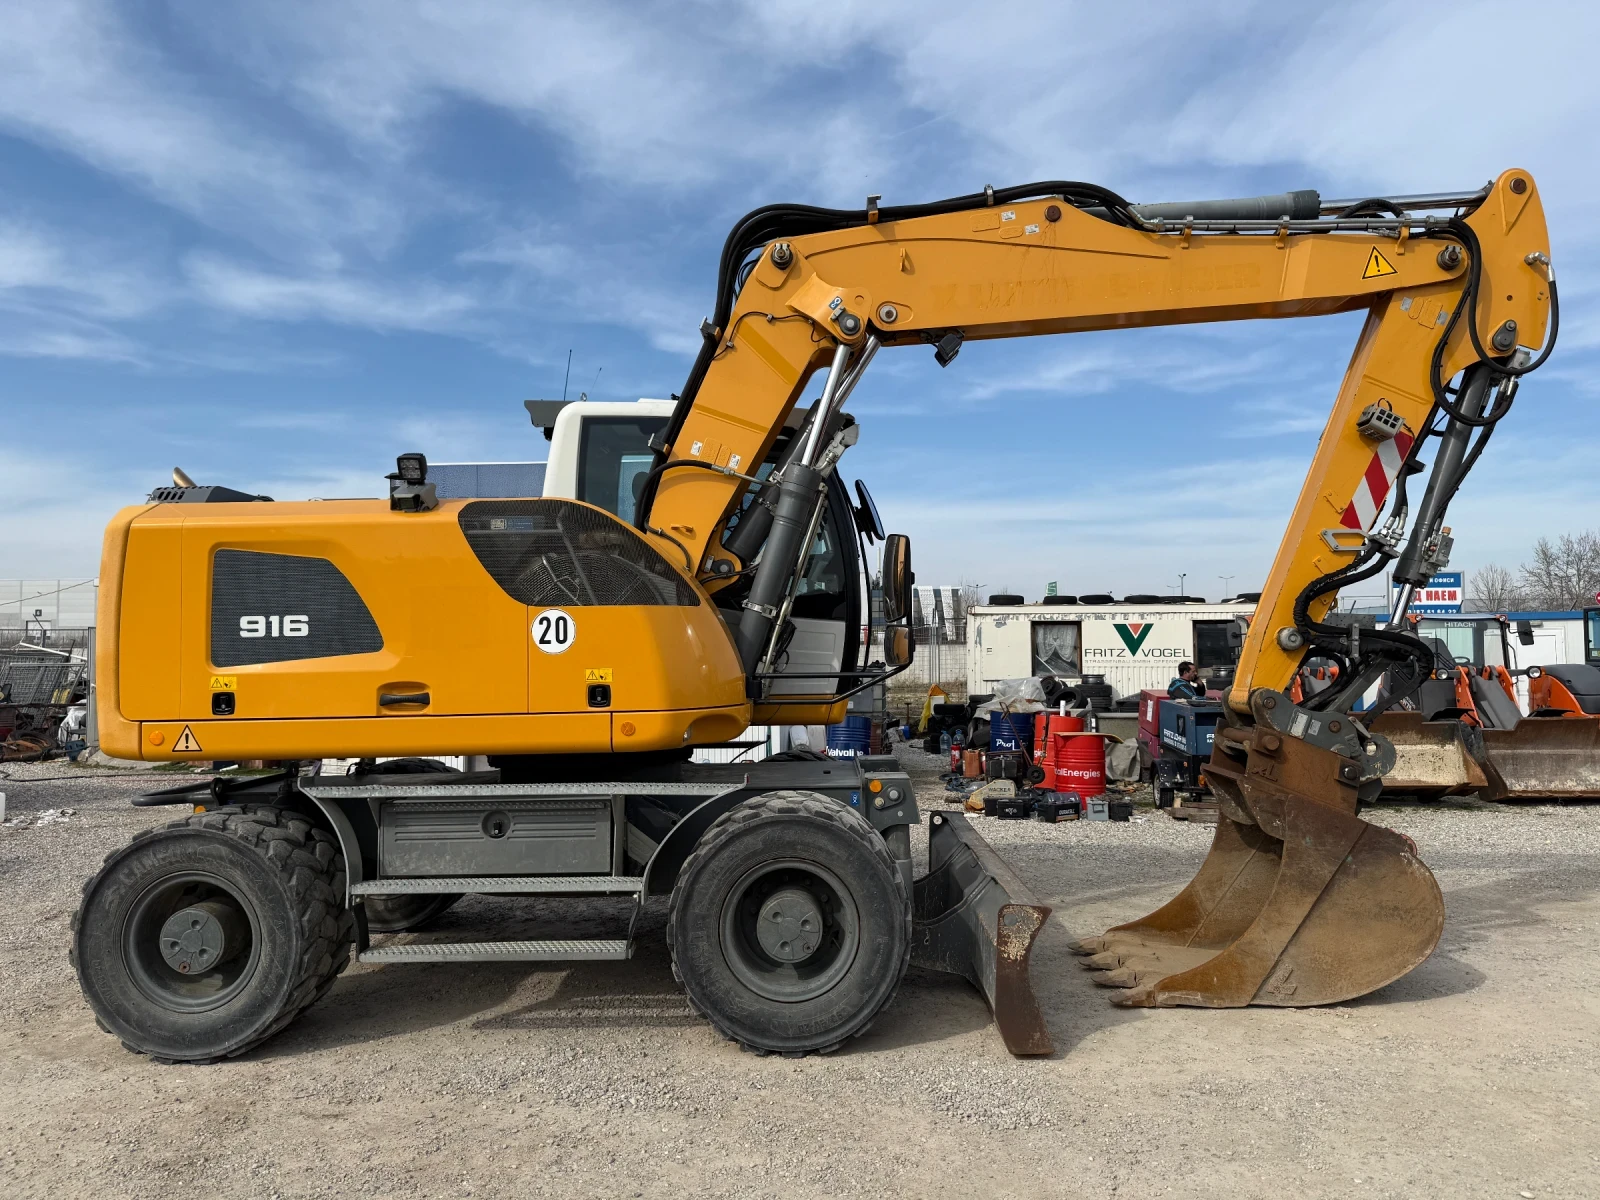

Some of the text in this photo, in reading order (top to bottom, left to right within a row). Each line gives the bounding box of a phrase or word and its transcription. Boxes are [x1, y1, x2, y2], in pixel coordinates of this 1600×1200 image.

[1426, 590, 1457, 602] НАЕМ
[240, 615, 309, 637] 916
[539, 616, 568, 645] 20
[1084, 648, 1191, 658] FRITZ VOGEL
